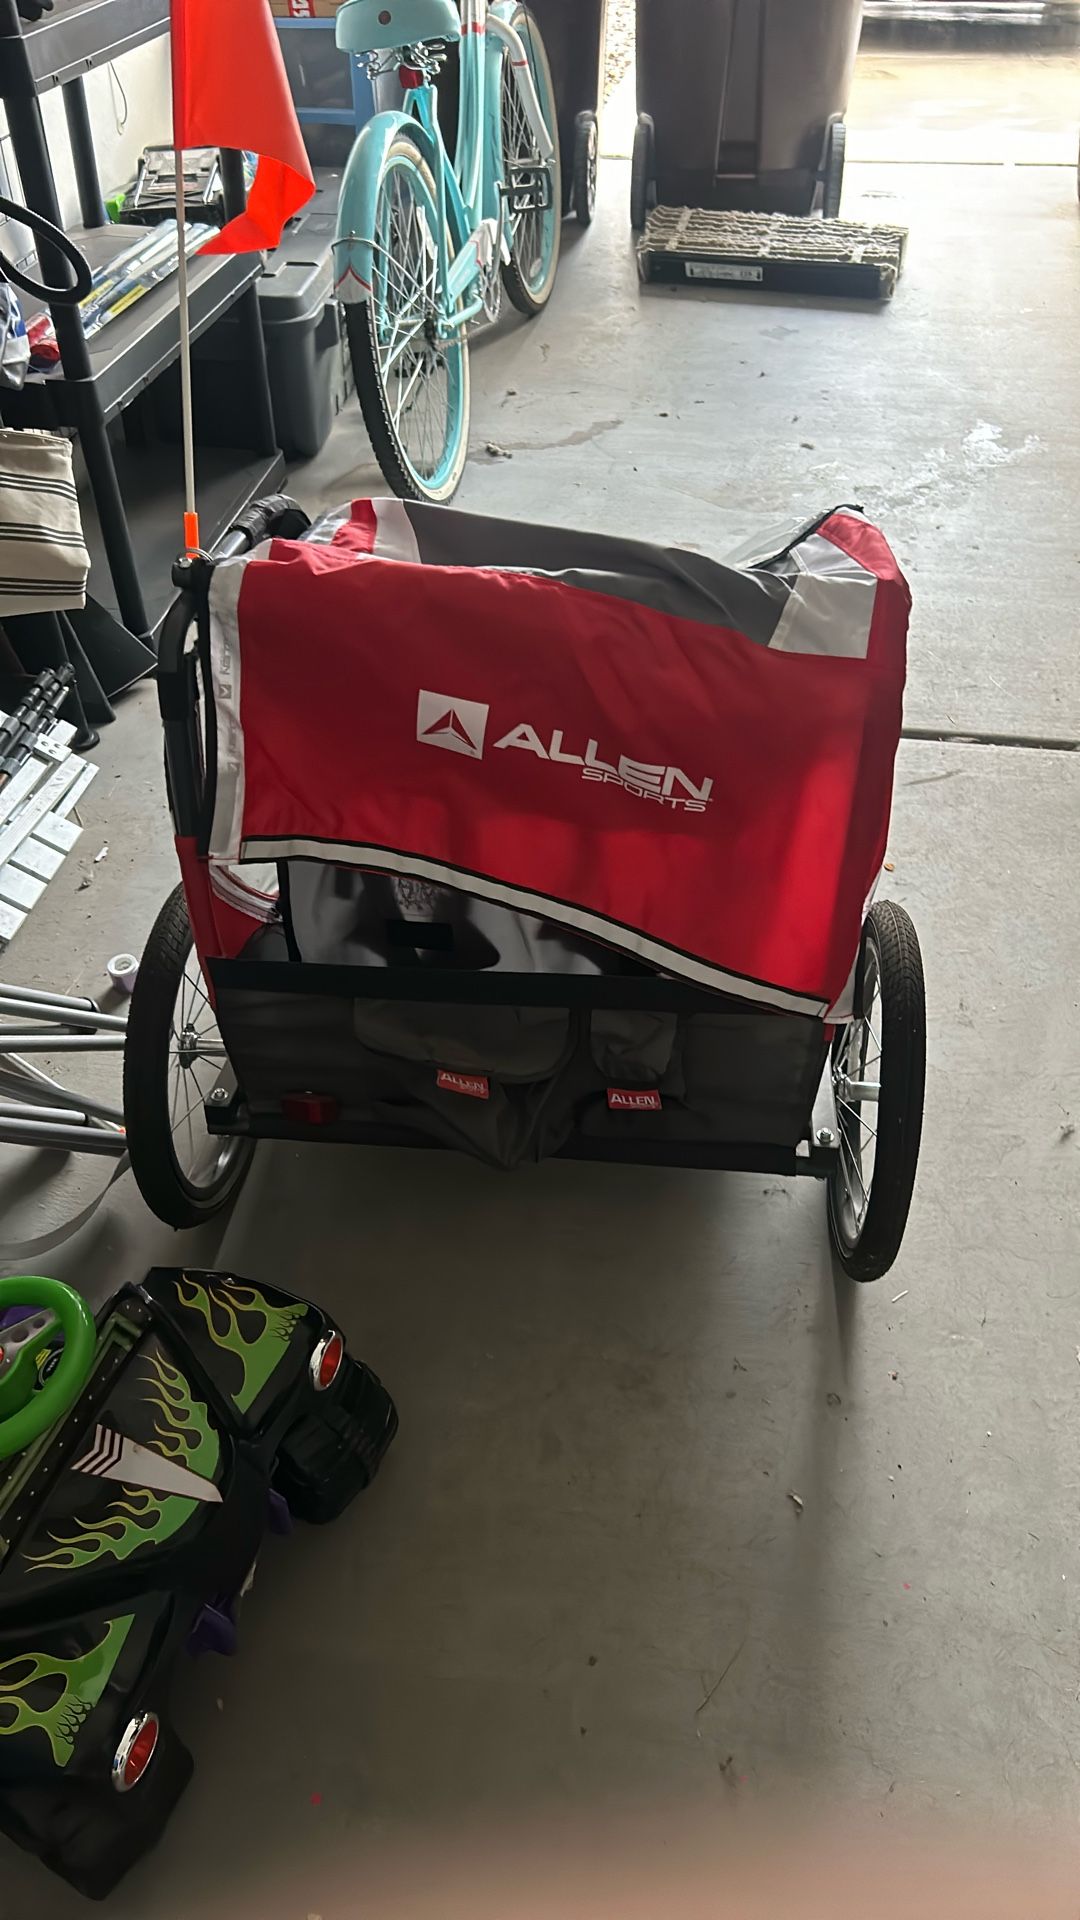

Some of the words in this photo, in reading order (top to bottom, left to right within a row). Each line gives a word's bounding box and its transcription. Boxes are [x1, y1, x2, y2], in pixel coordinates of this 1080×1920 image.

[493, 722, 714, 802] ALLEN
[581, 767, 707, 812] SPORTS
[440, 1072, 485, 1091] ALLEN
[610, 1093, 656, 1105] ALLEN
